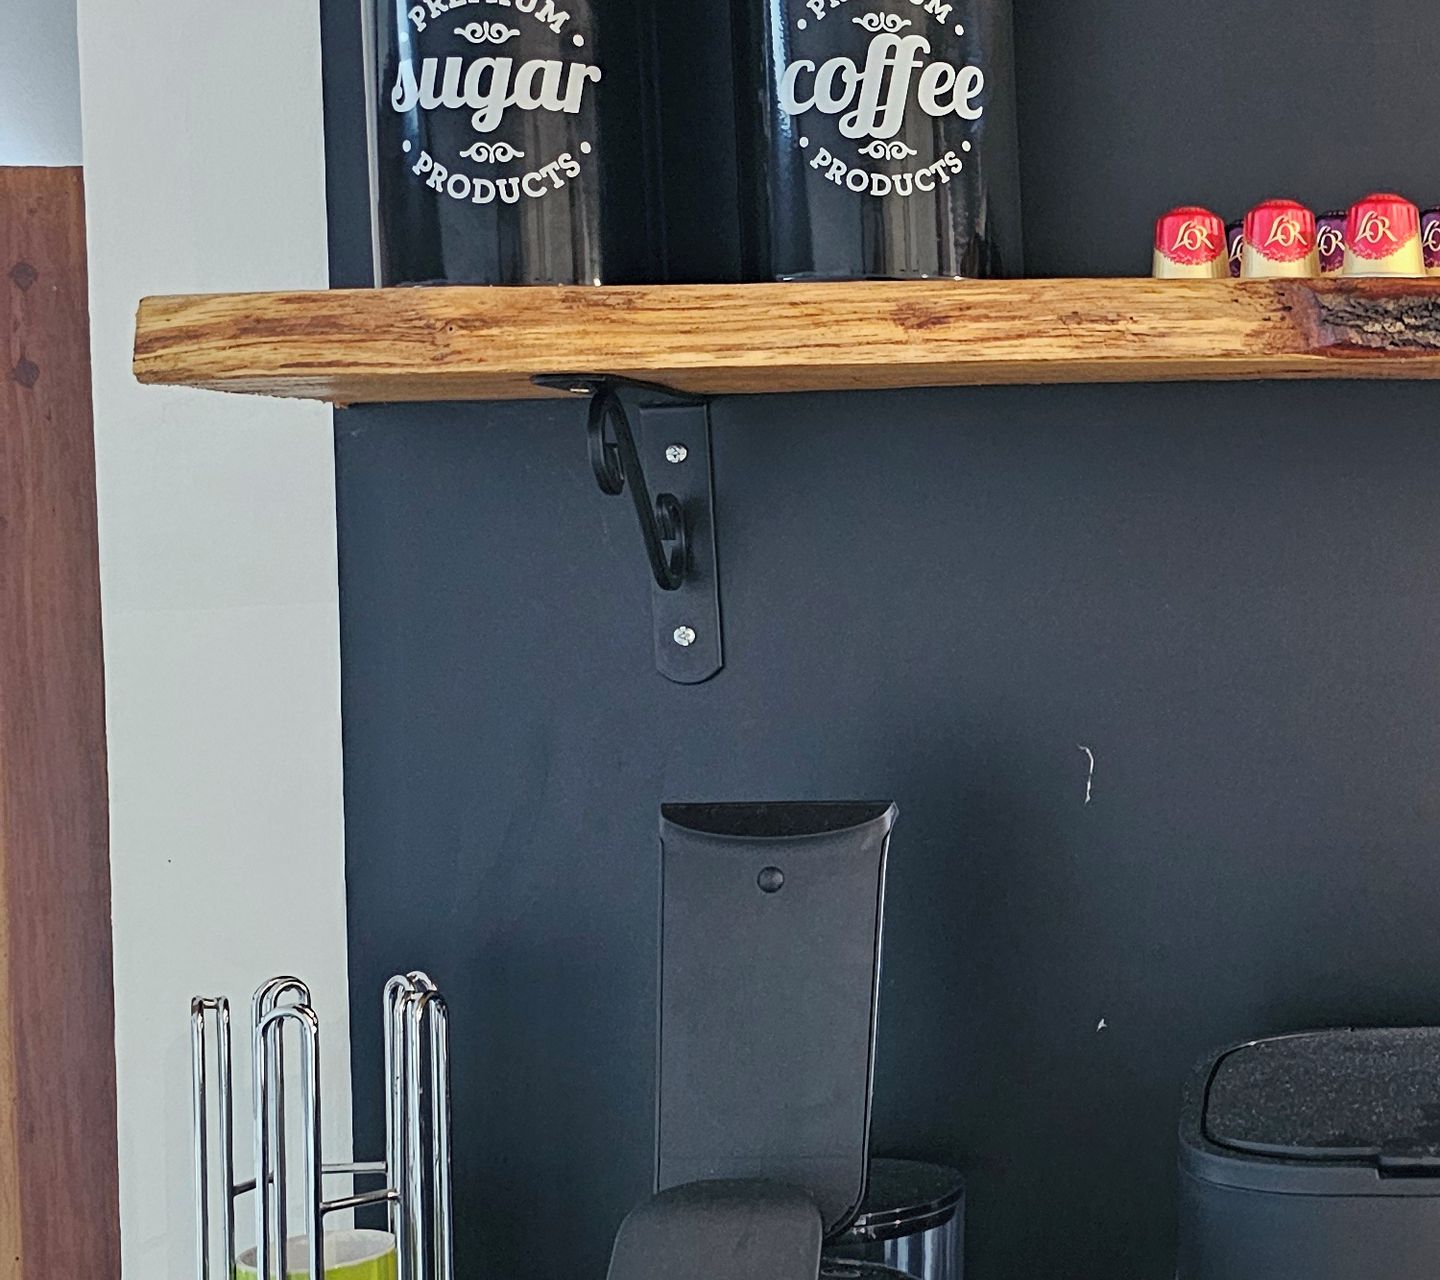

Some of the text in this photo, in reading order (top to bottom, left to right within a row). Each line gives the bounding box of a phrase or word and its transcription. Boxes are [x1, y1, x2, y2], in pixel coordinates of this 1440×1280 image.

[391, 56, 602, 133] sugar
[778, 33, 985, 139] coffee
[412, 150, 581, 204] PRODUCTS
[810, 146, 963, 197] PRODUCTS
[1171, 220, 1215, 251] L'OR
[1264, 215, 1308, 248] L'OR
[1354, 210, 1398, 244] L'OR
